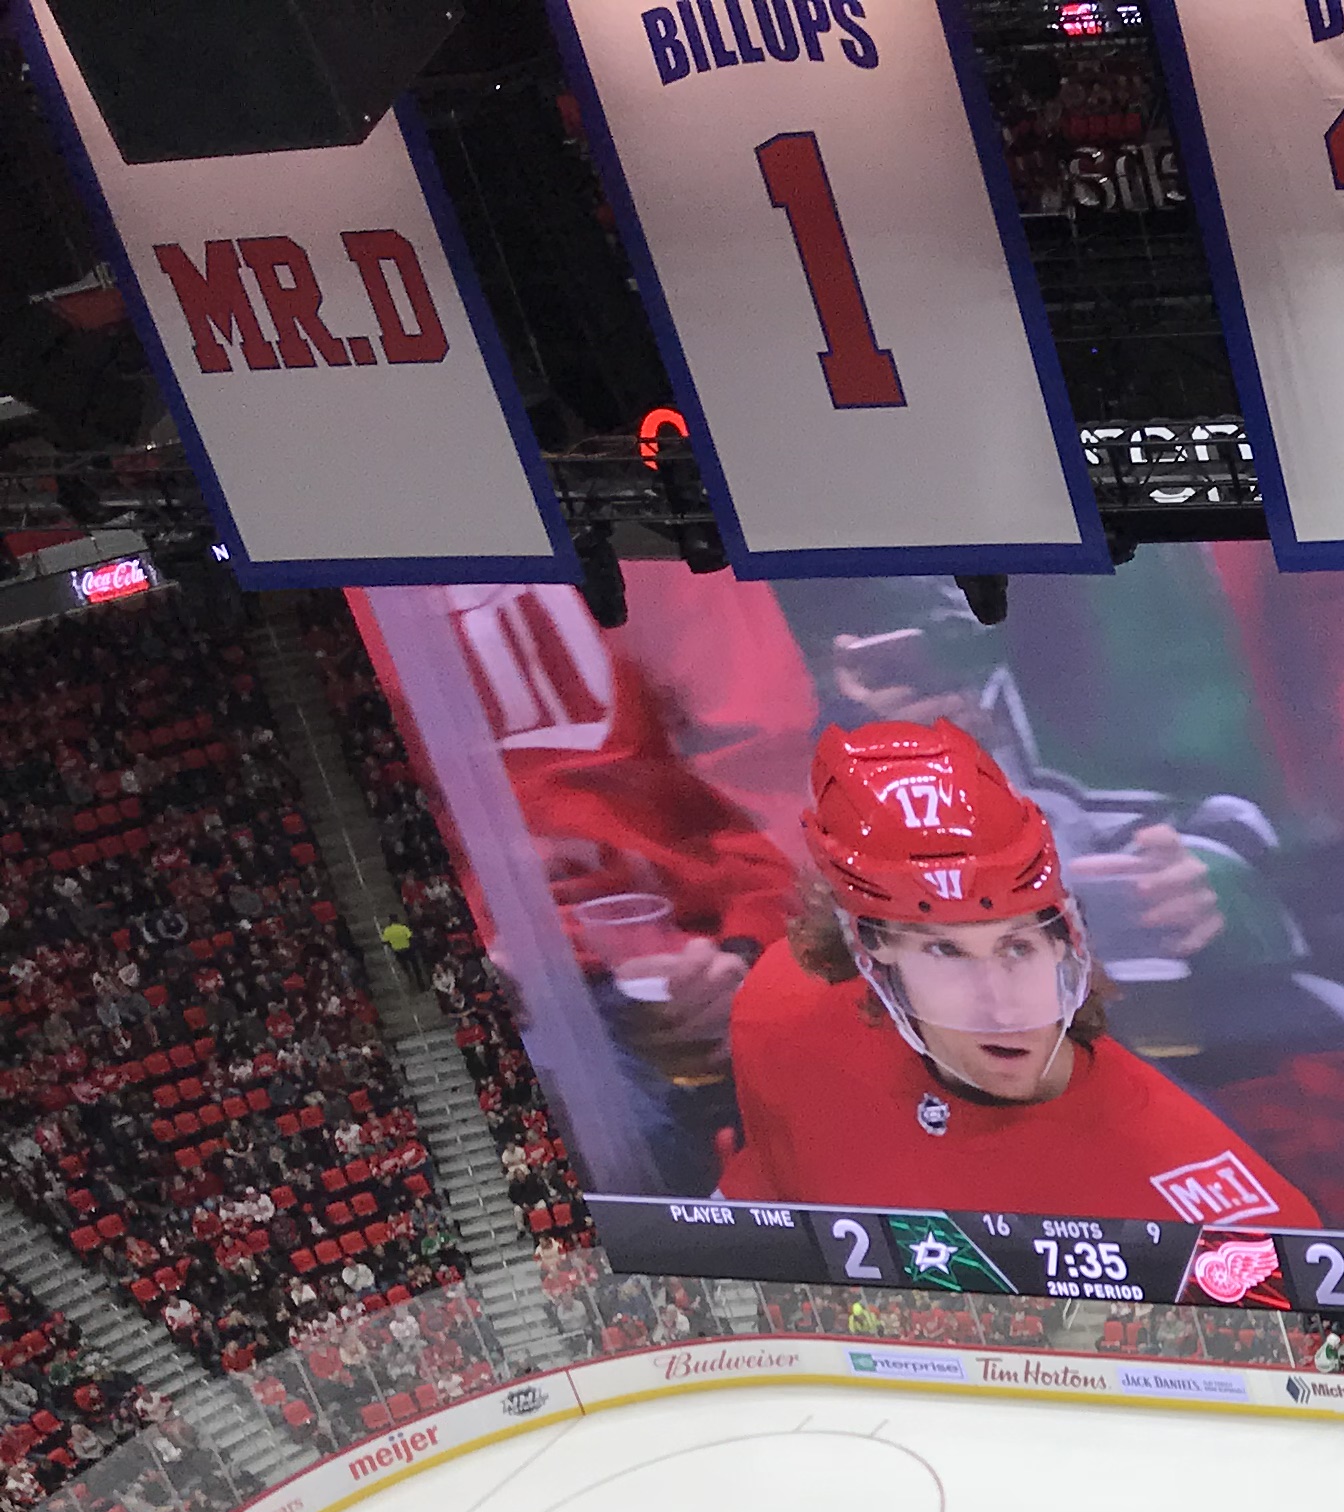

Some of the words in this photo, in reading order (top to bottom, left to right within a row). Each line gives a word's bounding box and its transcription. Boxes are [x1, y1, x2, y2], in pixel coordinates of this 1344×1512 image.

[642, 0, 879, 86] BILLUPS
[754, 131, 908, 409] 1
[896, 782, 943, 828] 17
[671, 1204, 735, 1225] PLAYER
[750, 1208, 795, 1228] TIME
[983, 1213, 1010, 1237] 16
[1042, 1220, 1103, 1240] SHOTS
[1147, 1222, 1161, 1244] 9
[831, 1218, 882, 1279] 2
[1034, 1239, 1128, 1281] 7:35
[1048, 1281, 1079, 1298] 2ND
[1083, 1283, 1143, 1301] PERIOD
[654, 1350, 800, 1381] Budweiser
[976, 1357, 1020, 1383] Tim
[1023, 1359, 1107, 1391] Hortons
[349, 1423, 439, 1481] meijer
